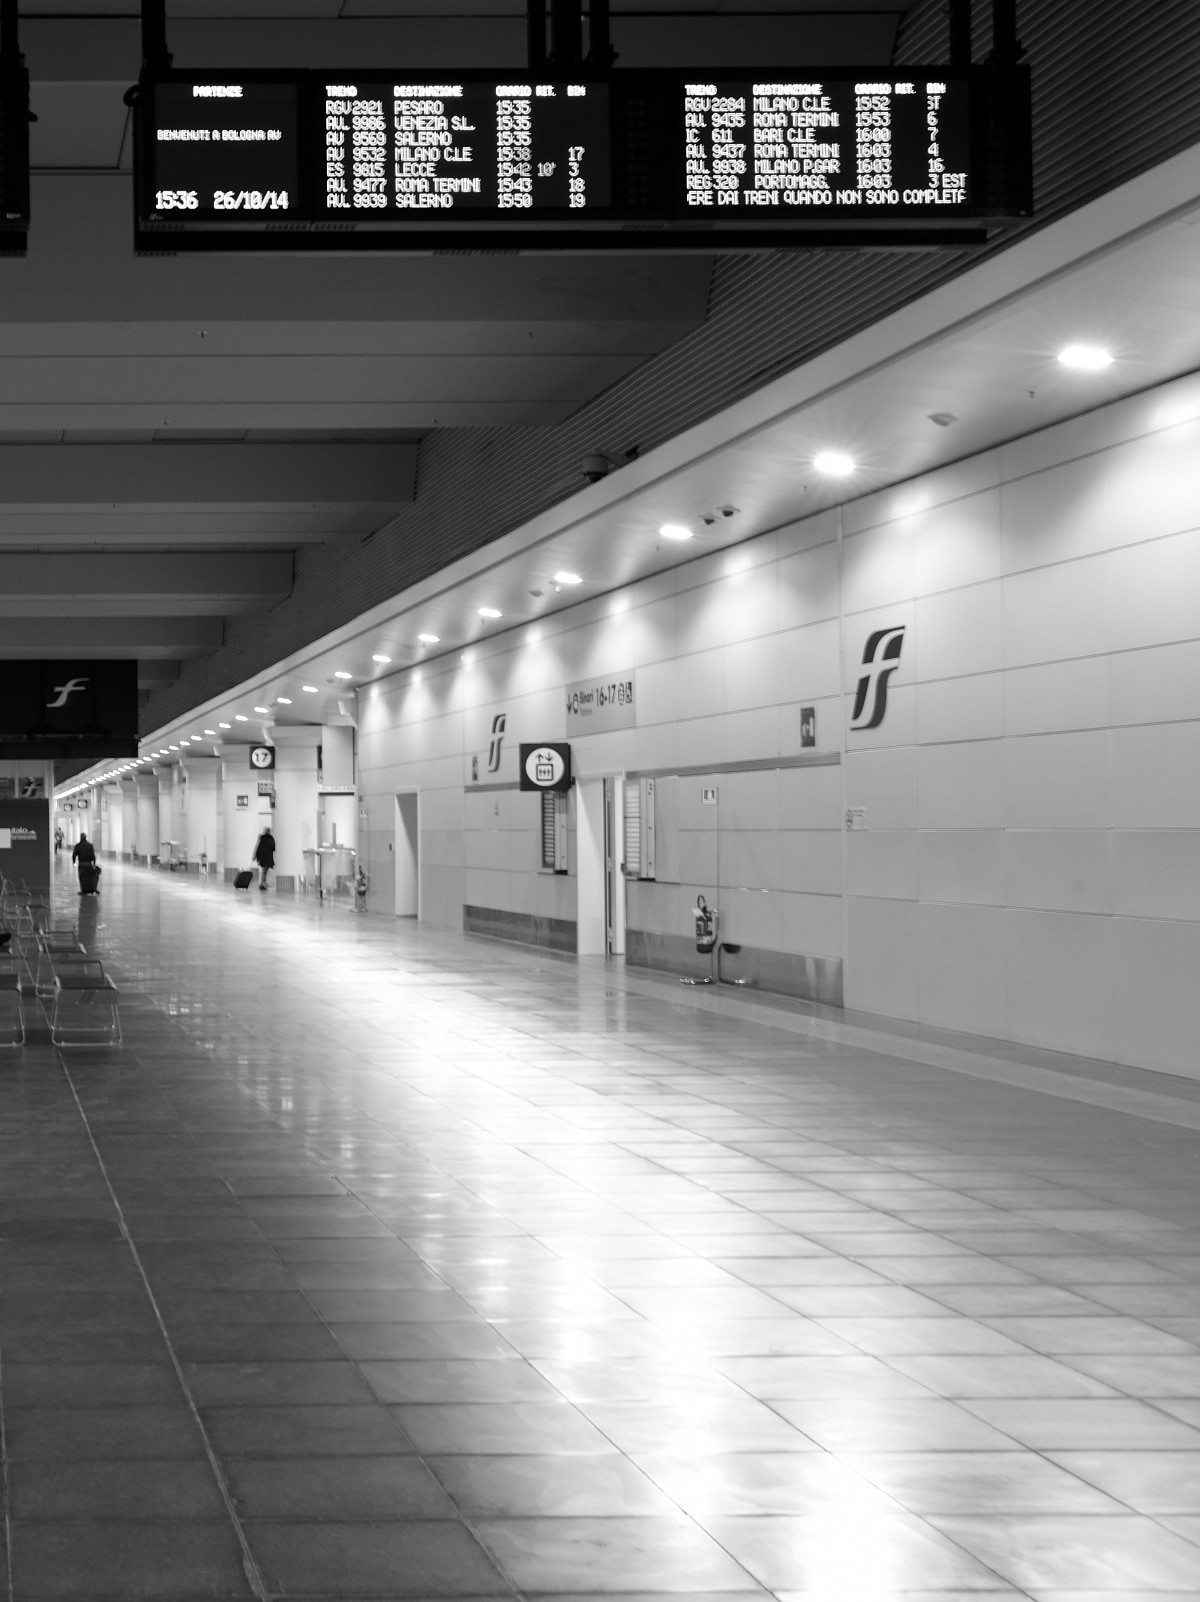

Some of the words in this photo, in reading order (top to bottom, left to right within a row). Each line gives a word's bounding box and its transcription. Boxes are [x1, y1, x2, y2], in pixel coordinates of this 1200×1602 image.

[394, 100, 444, 115] PESARO
[496, 100, 532, 115] 15:35
[753, 97, 799, 112] MILANO
[855, 97, 891, 111] 15:52
[394, 116, 448, 131] VENEZIA
[496, 116, 532, 130] 15:35
[711, 113, 746, 127] 9435
[753, 113, 788, 127] ROMA
[791, 112, 840, 127] TERMINI
[856, 112, 891, 127] 15:53
[927, 111, 938, 126] 6
[212, 130, 220, 141] A
[222, 130, 266, 141] BOLOGNA
[352, 131, 387, 146] 9569
[394, 131, 453, 146] SALERNO
[497, 131, 532, 146] 15:35
[712, 128, 734, 143] 611
[754, 128, 784, 143] BARI
[856, 128, 891, 142] 16:00
[928, 127, 938, 142] 7
[353, 147, 387, 161] 9532
[395, 147, 441, 161] MILANO
[497, 147, 532, 161] 15:38
[568, 146, 585, 161] 17
[712, 144, 746, 158] 9437
[754, 144, 788, 158] ROMA
[792, 143, 840, 158] TERMINI
[856, 143, 892, 158] 16:03
[928, 142, 939, 157] 4
[327, 162, 345, 177] ES
[353, 162, 385, 177] 9815
[395, 162, 437, 177] LECCE
[497, 162, 532, 177] 15:42
[569, 162, 579, 177] 3
[754, 159, 800, 174] MILANO
[856, 158, 892, 174] 16:03
[928, 158, 945, 173] 16
[353, 178, 387, 193] 9477
[395, 178, 429, 193] ROMA
[433, 178, 481, 193] TERMINI
[497, 178, 532, 192] 15:43
[569, 178, 586, 192] 18
[857, 174, 892, 189] 16:03
[942, 173, 968, 188] EST
[156, 191, 199, 210] 15:36
[214, 191, 289, 210] 26/10/14
[396, 193, 453, 208] SALERNO
[498, 193, 533, 208] 15:50
[569, 193, 586, 207] 19
[687, 190, 714, 205] ERE
[718, 190, 739, 205] DAI
[743, 190, 779, 205] TRENI
[783, 190, 832, 205] QUANDO
[836, 190, 862, 205] NON
[866, 190, 899, 205] SONO
[255, 752, 268, 762] 17
